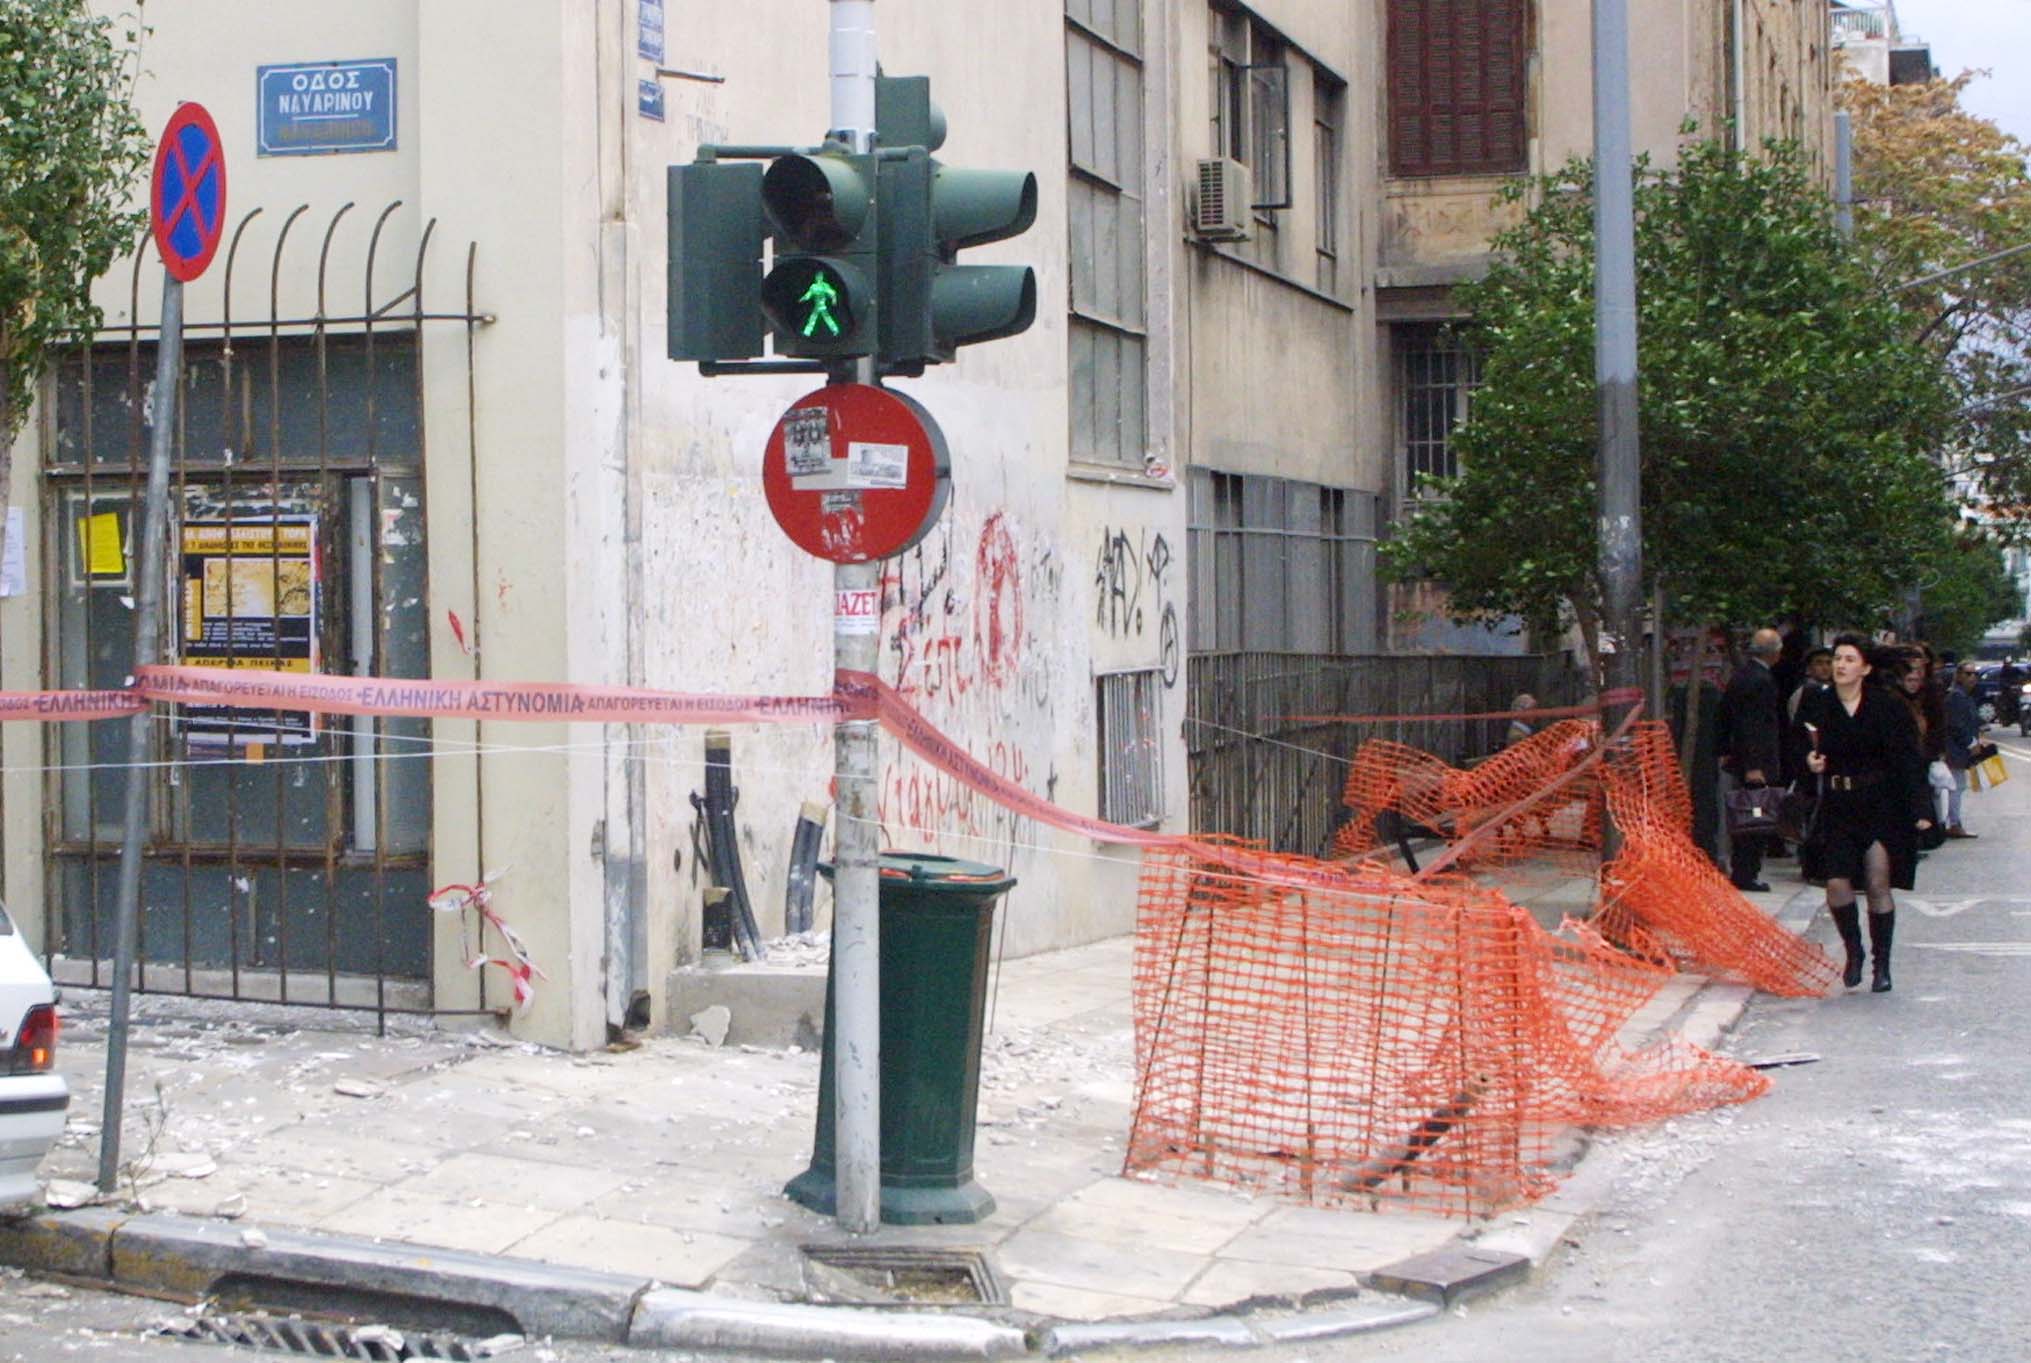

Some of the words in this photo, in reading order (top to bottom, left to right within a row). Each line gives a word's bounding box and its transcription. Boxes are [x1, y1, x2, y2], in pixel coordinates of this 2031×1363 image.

[292, 71, 360, 91] ΟΔΟΣ
[279, 91, 374, 113] ΝΑΥΑΡΙΝΟΥ
[192, 680, 287, 697] ΑΠΑΓΟΡΕΥΕΤΑΙ
[361, 687, 462, 711] ΕΛΛΗΝΙΚΗ
[467, 690, 585, 713] ΑΣΤΥΝΟΜΙΑ
[587, 696, 684, 712] ΑΠΑΓΟΡΕΥΕΤΑΙ
